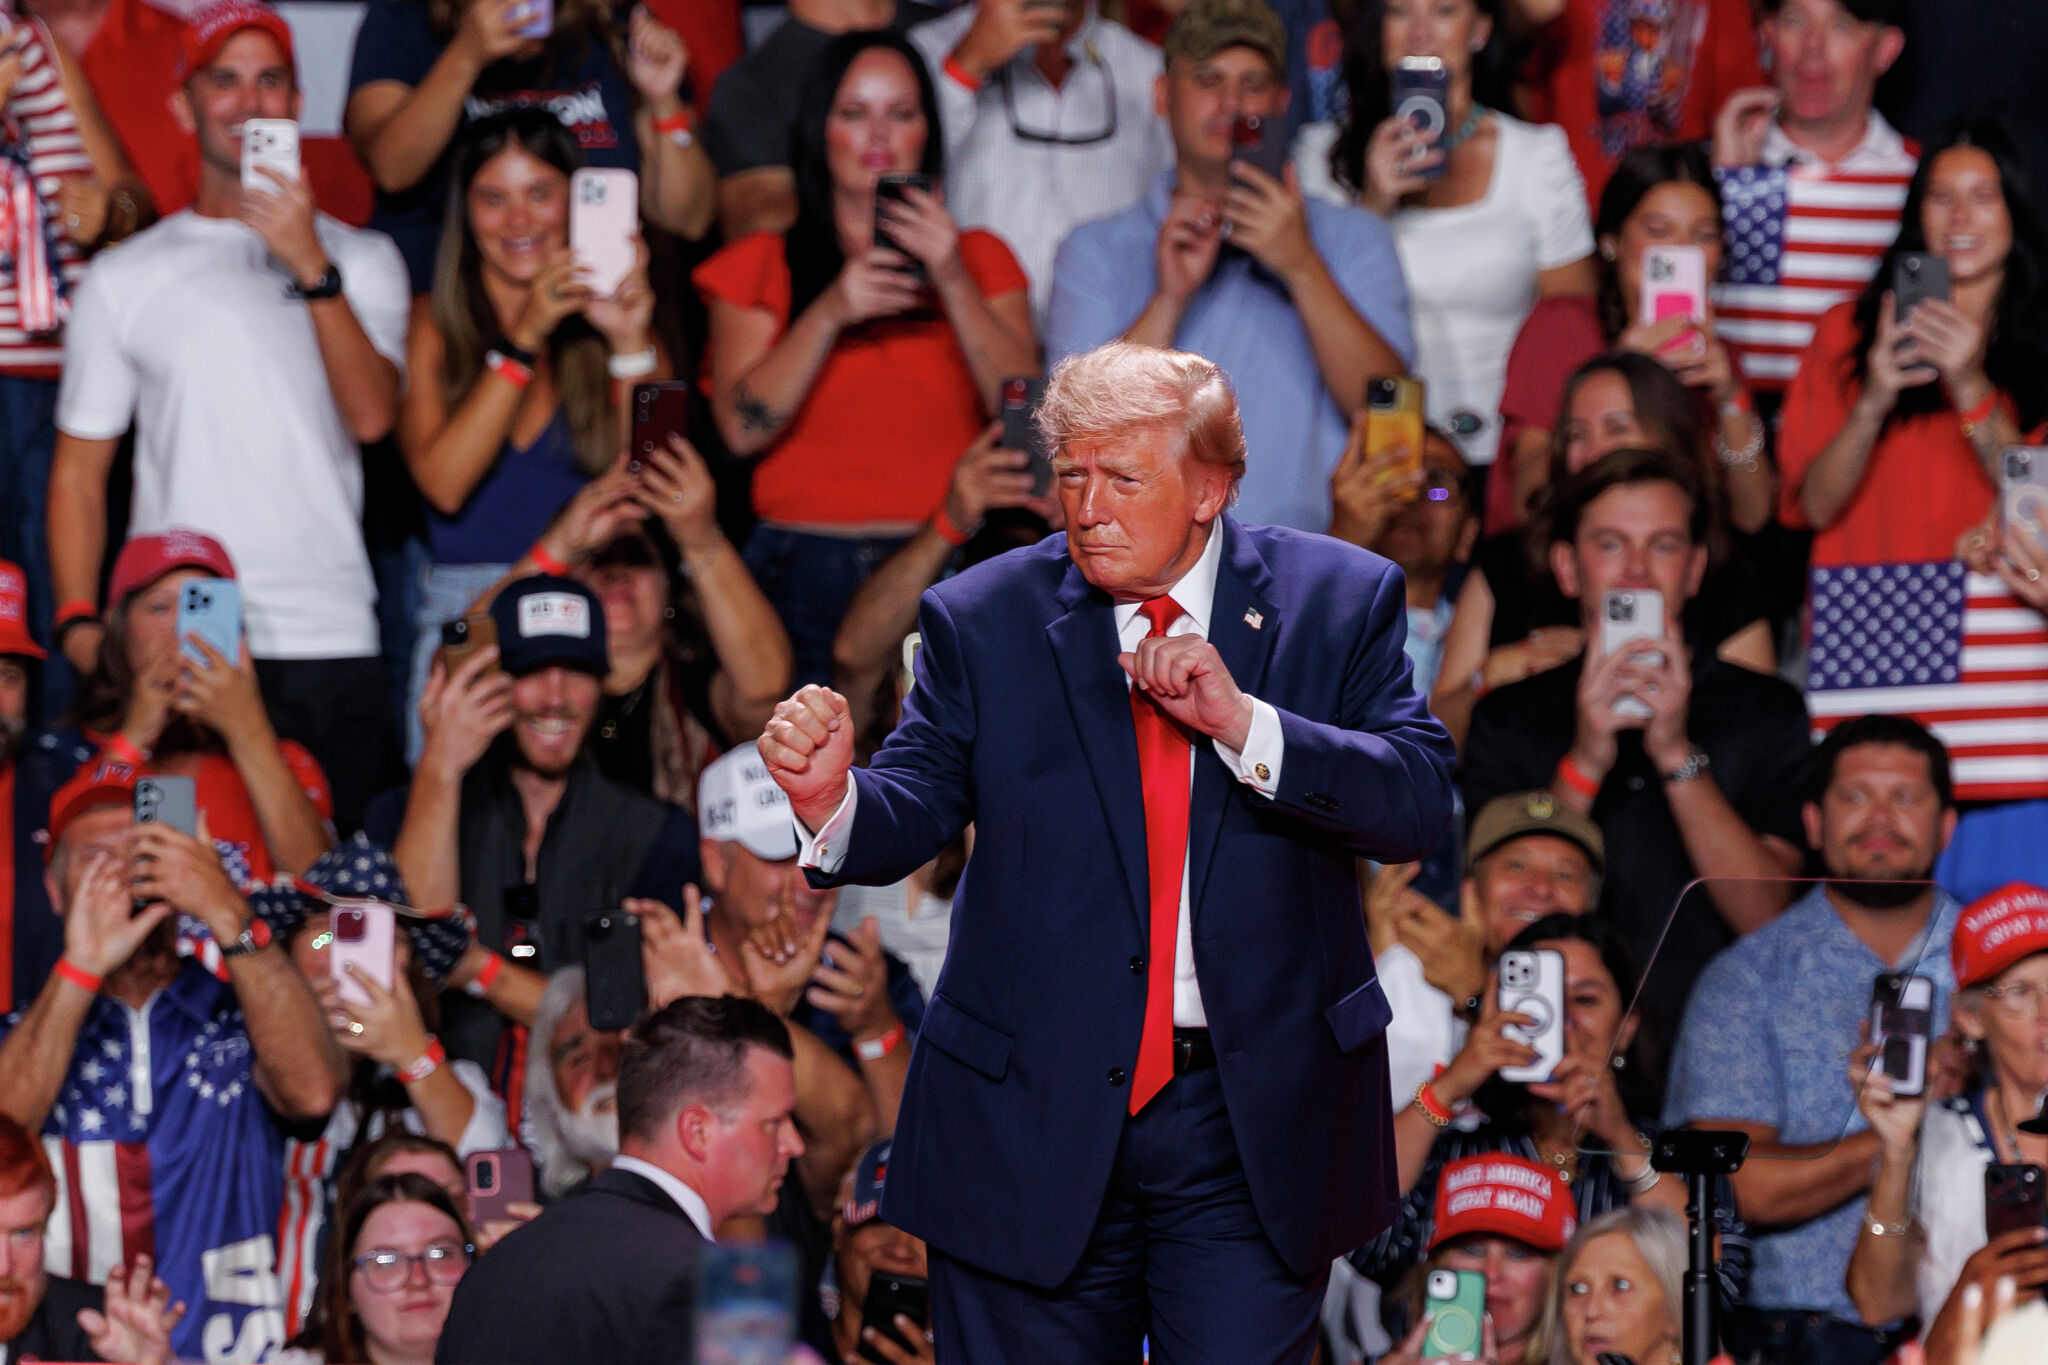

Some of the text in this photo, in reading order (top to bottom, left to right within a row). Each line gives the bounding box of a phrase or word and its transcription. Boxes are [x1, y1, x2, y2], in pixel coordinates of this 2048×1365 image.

[1446, 1163, 1552, 1199] MAKE AMERICA
[1447, 1186, 1545, 1220] GREAT AGAIN
